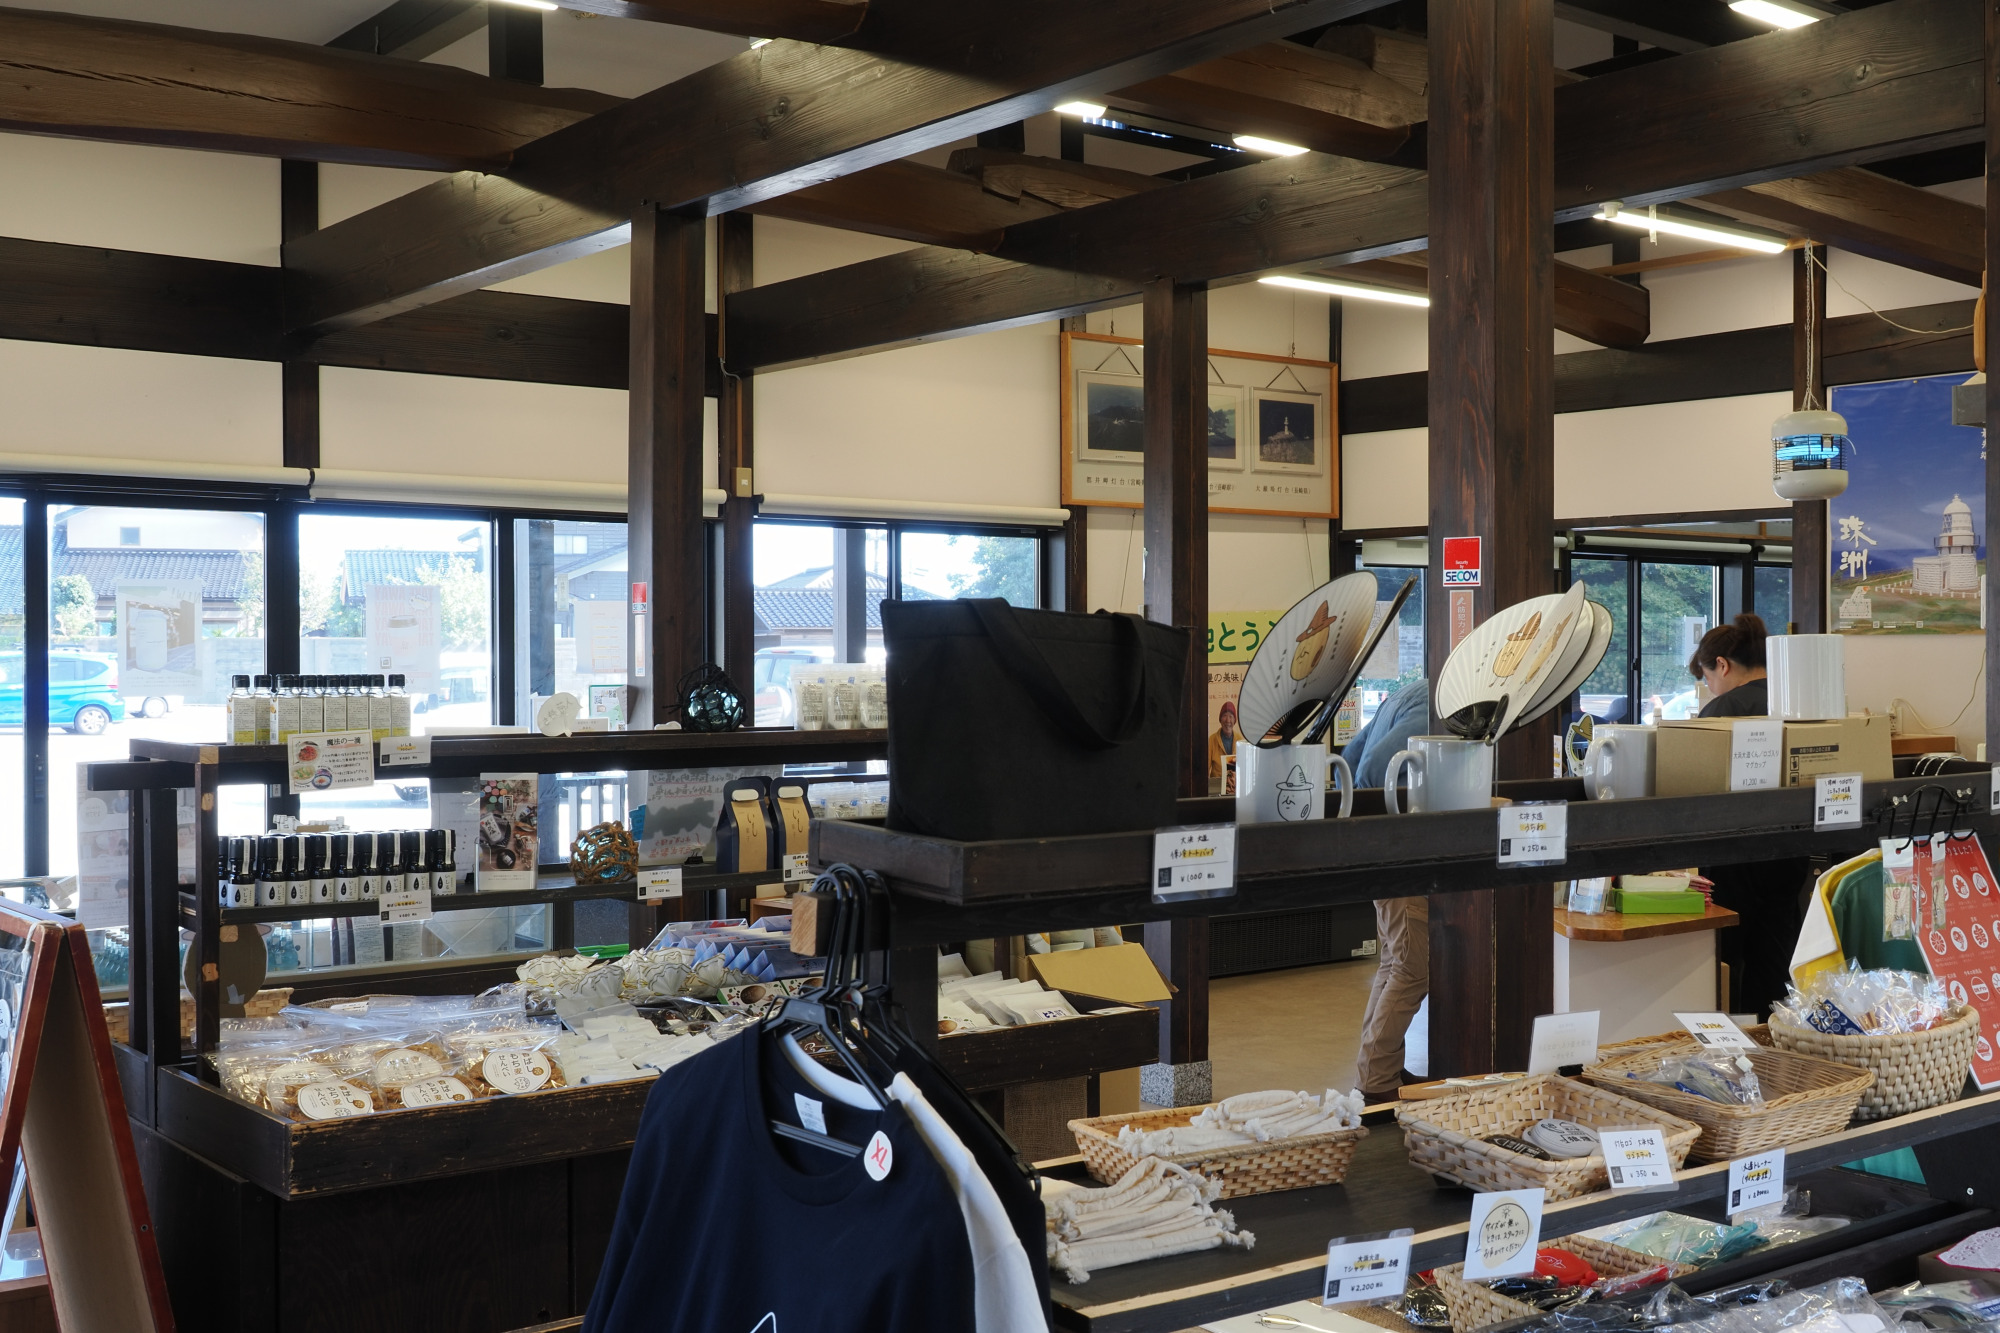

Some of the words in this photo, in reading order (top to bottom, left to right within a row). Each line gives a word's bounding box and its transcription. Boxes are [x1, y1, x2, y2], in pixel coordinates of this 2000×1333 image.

[1838, 516, 1877, 580] 珠洲
[1446, 571, 1478, 581] SECOM
[326, 736, 362, 746] 魔法の一滴
[1745, 761, 1767, 769] マグカップ
[1742, 778, 1758, 786] ¥1,200
[1524, 823, 1545, 832] うちわ
[871, 1139, 888, 1172] XL
[1350, 1282, 1374, 1292] ¥2,200
